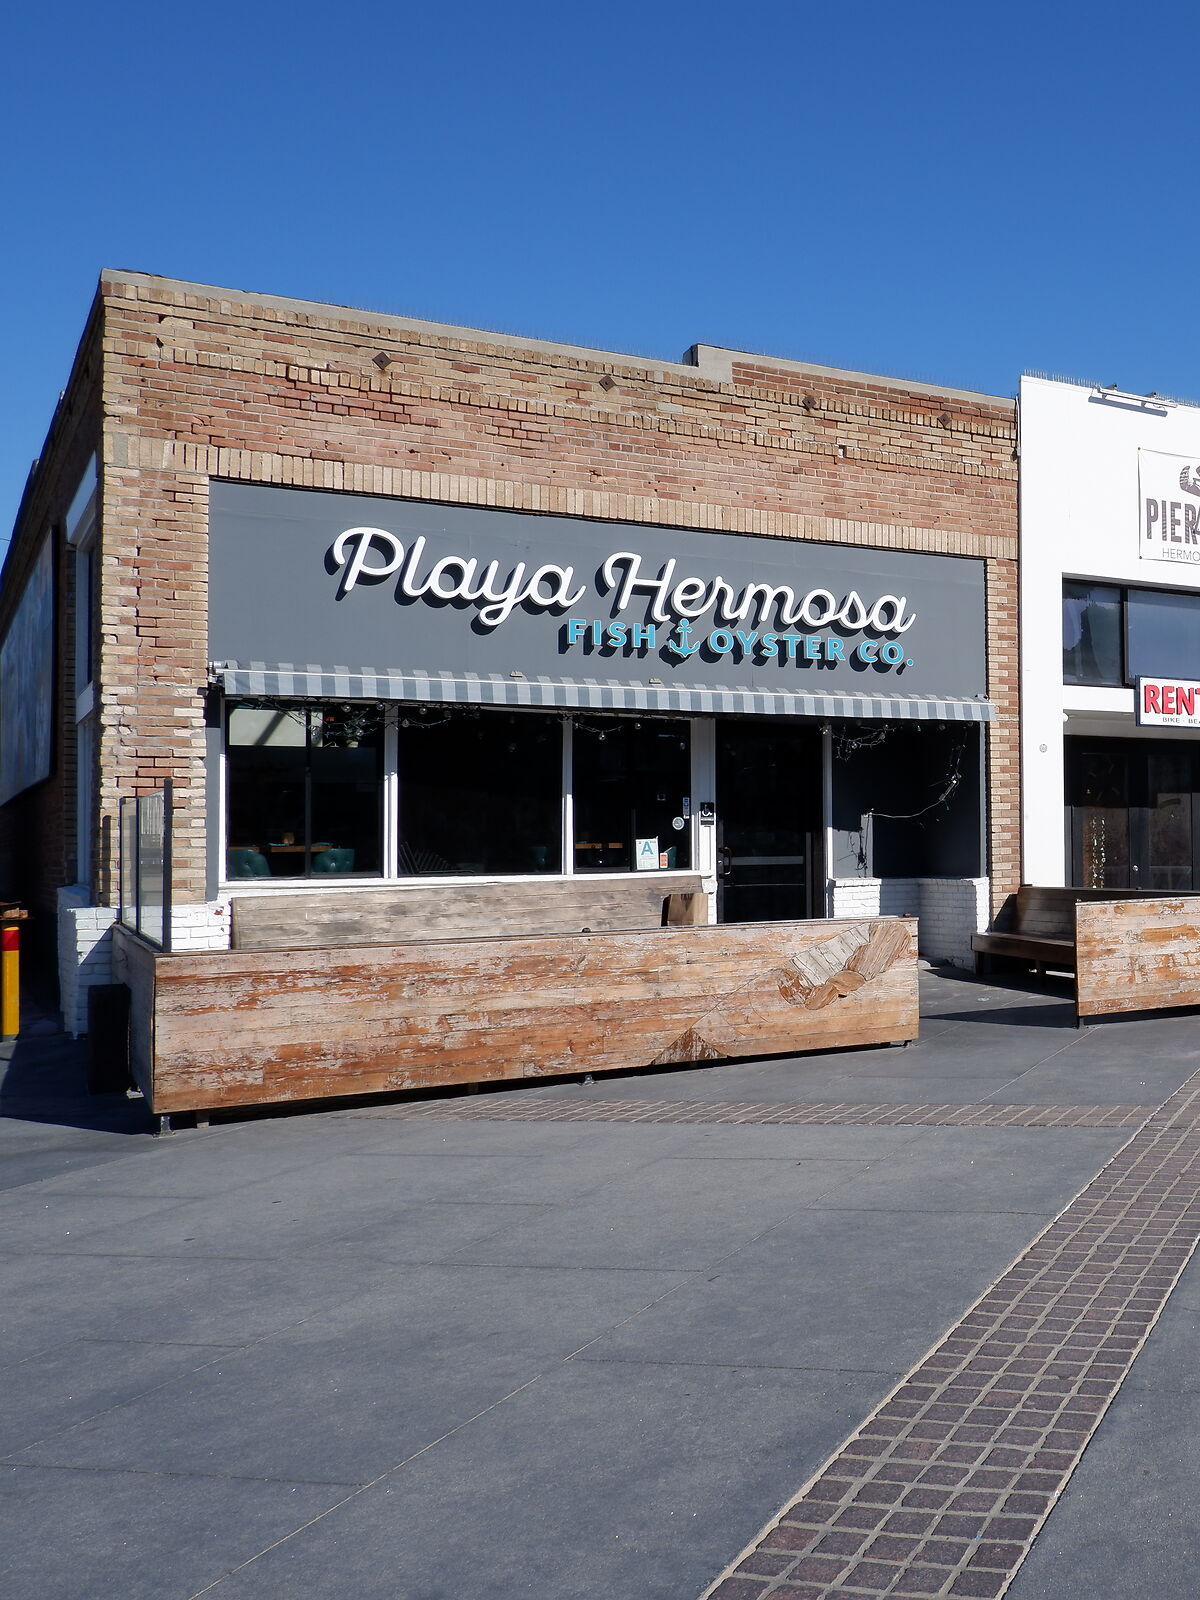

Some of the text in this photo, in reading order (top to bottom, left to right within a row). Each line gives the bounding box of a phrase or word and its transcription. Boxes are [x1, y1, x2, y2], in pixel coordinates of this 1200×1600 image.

[1146, 498, 1198, 545] PIER
[333, 527, 917, 633] Playa Hermosa
[568, 618, 915, 667] FISH OYSTER CO.
[640, 841, 654, 856] A
